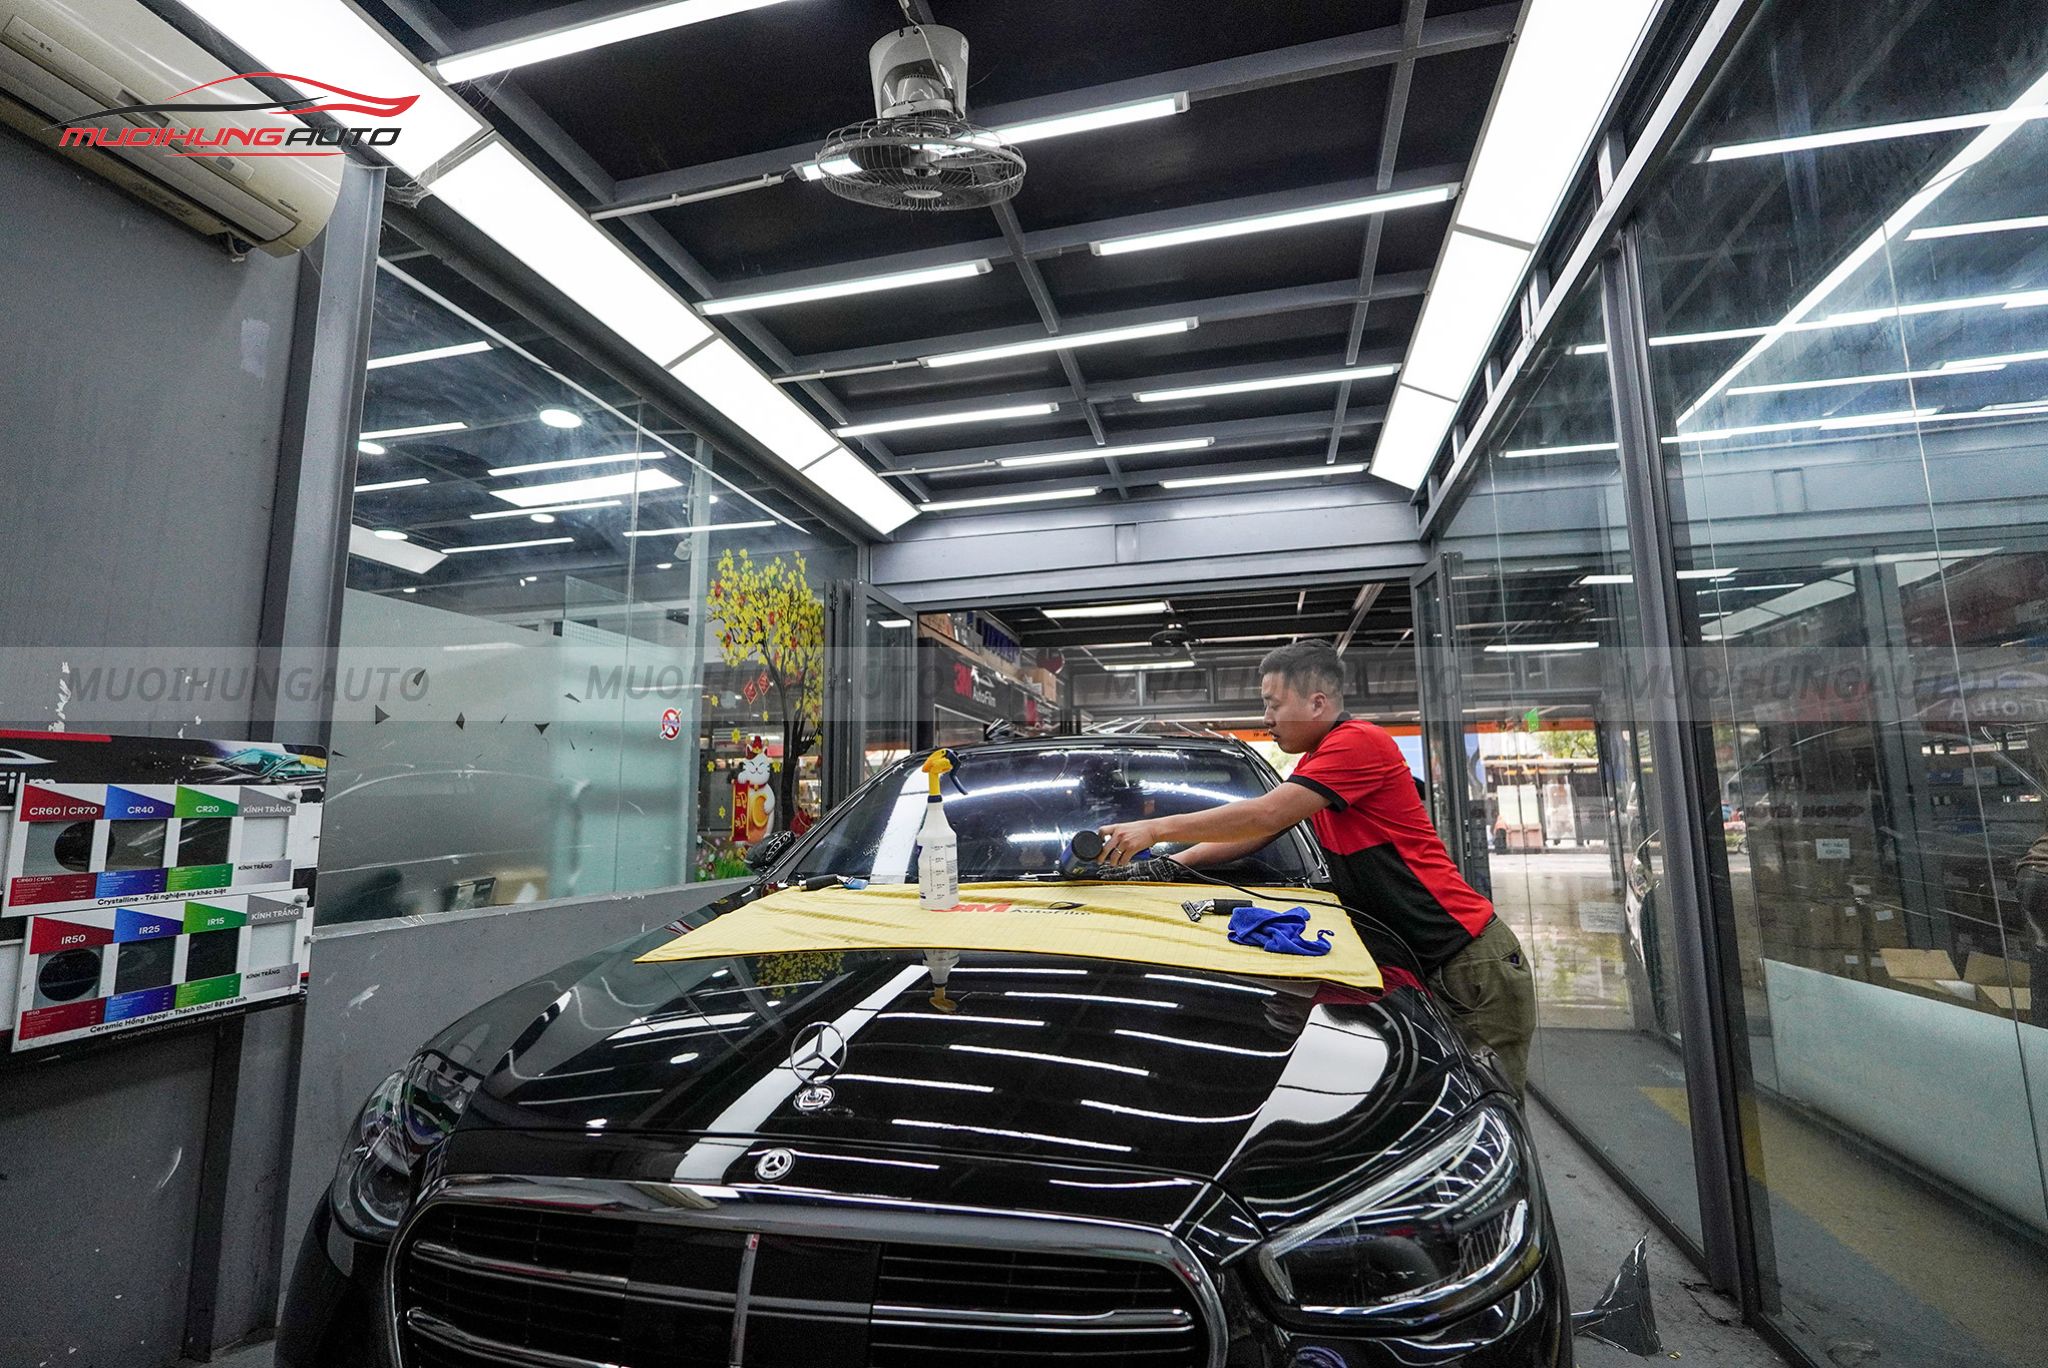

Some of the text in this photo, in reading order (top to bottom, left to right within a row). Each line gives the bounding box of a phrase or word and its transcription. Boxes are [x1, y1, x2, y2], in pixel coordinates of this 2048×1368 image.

[29, 807, 61, 816] CR60
[68, 806, 98, 815] CR70
[127, 806, 154, 814] CR40
[195, 805, 219, 813] CR20
[97, 896, 138, 906] Crystalline
[206, 917, 225, 926] IR15
[138, 925, 161, 935] IR25
[61, 934, 87, 945] IR50
[89, 1022, 123, 1033] Ceramic
